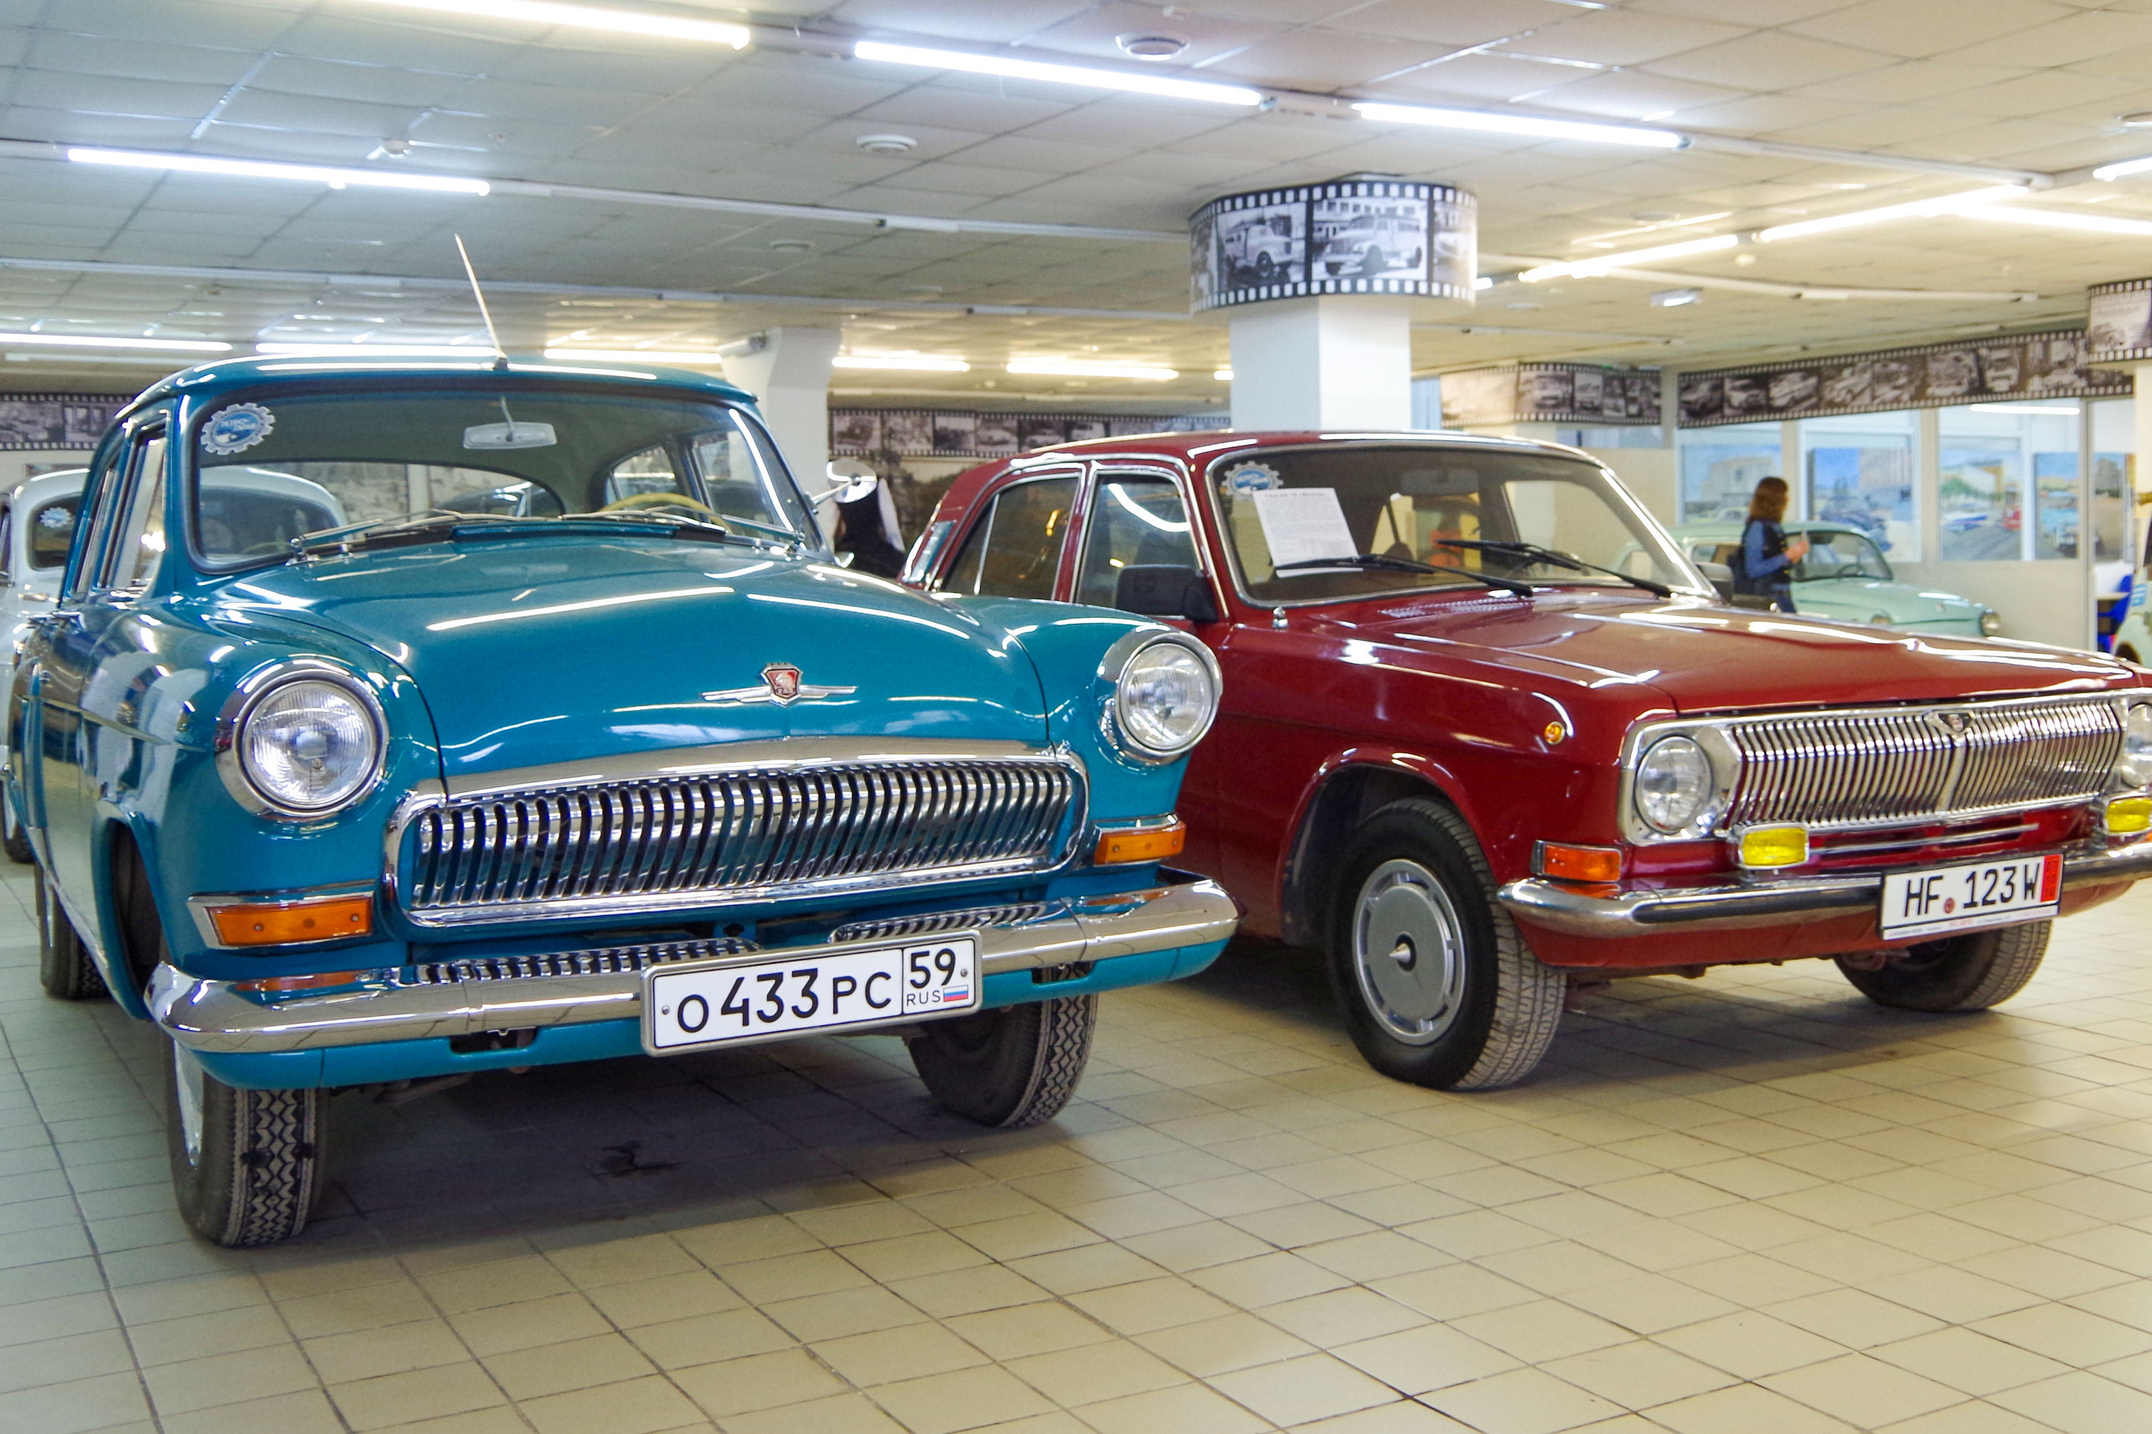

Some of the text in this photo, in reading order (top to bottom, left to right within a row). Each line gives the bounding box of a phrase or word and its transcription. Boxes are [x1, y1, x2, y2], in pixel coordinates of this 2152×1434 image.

[1904, 875, 1944, 917] HF
[909, 948, 956, 989] 59
[906, 990, 942, 1007] RUS
